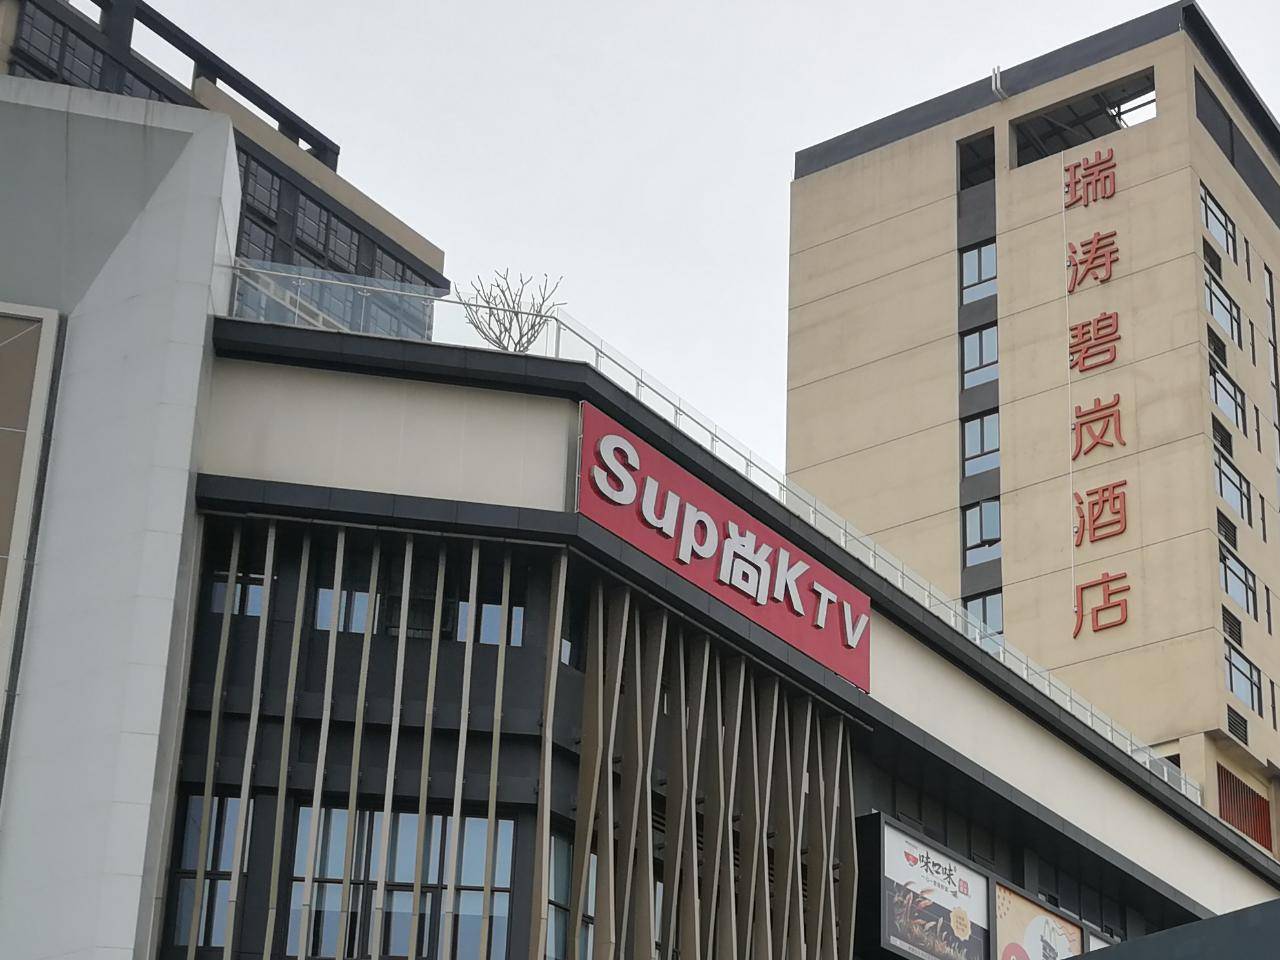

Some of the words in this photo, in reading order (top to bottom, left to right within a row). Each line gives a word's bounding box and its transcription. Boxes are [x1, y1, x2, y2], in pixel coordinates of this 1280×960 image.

[1064, 148, 1130, 639] 瑞涛碧岚酒店
